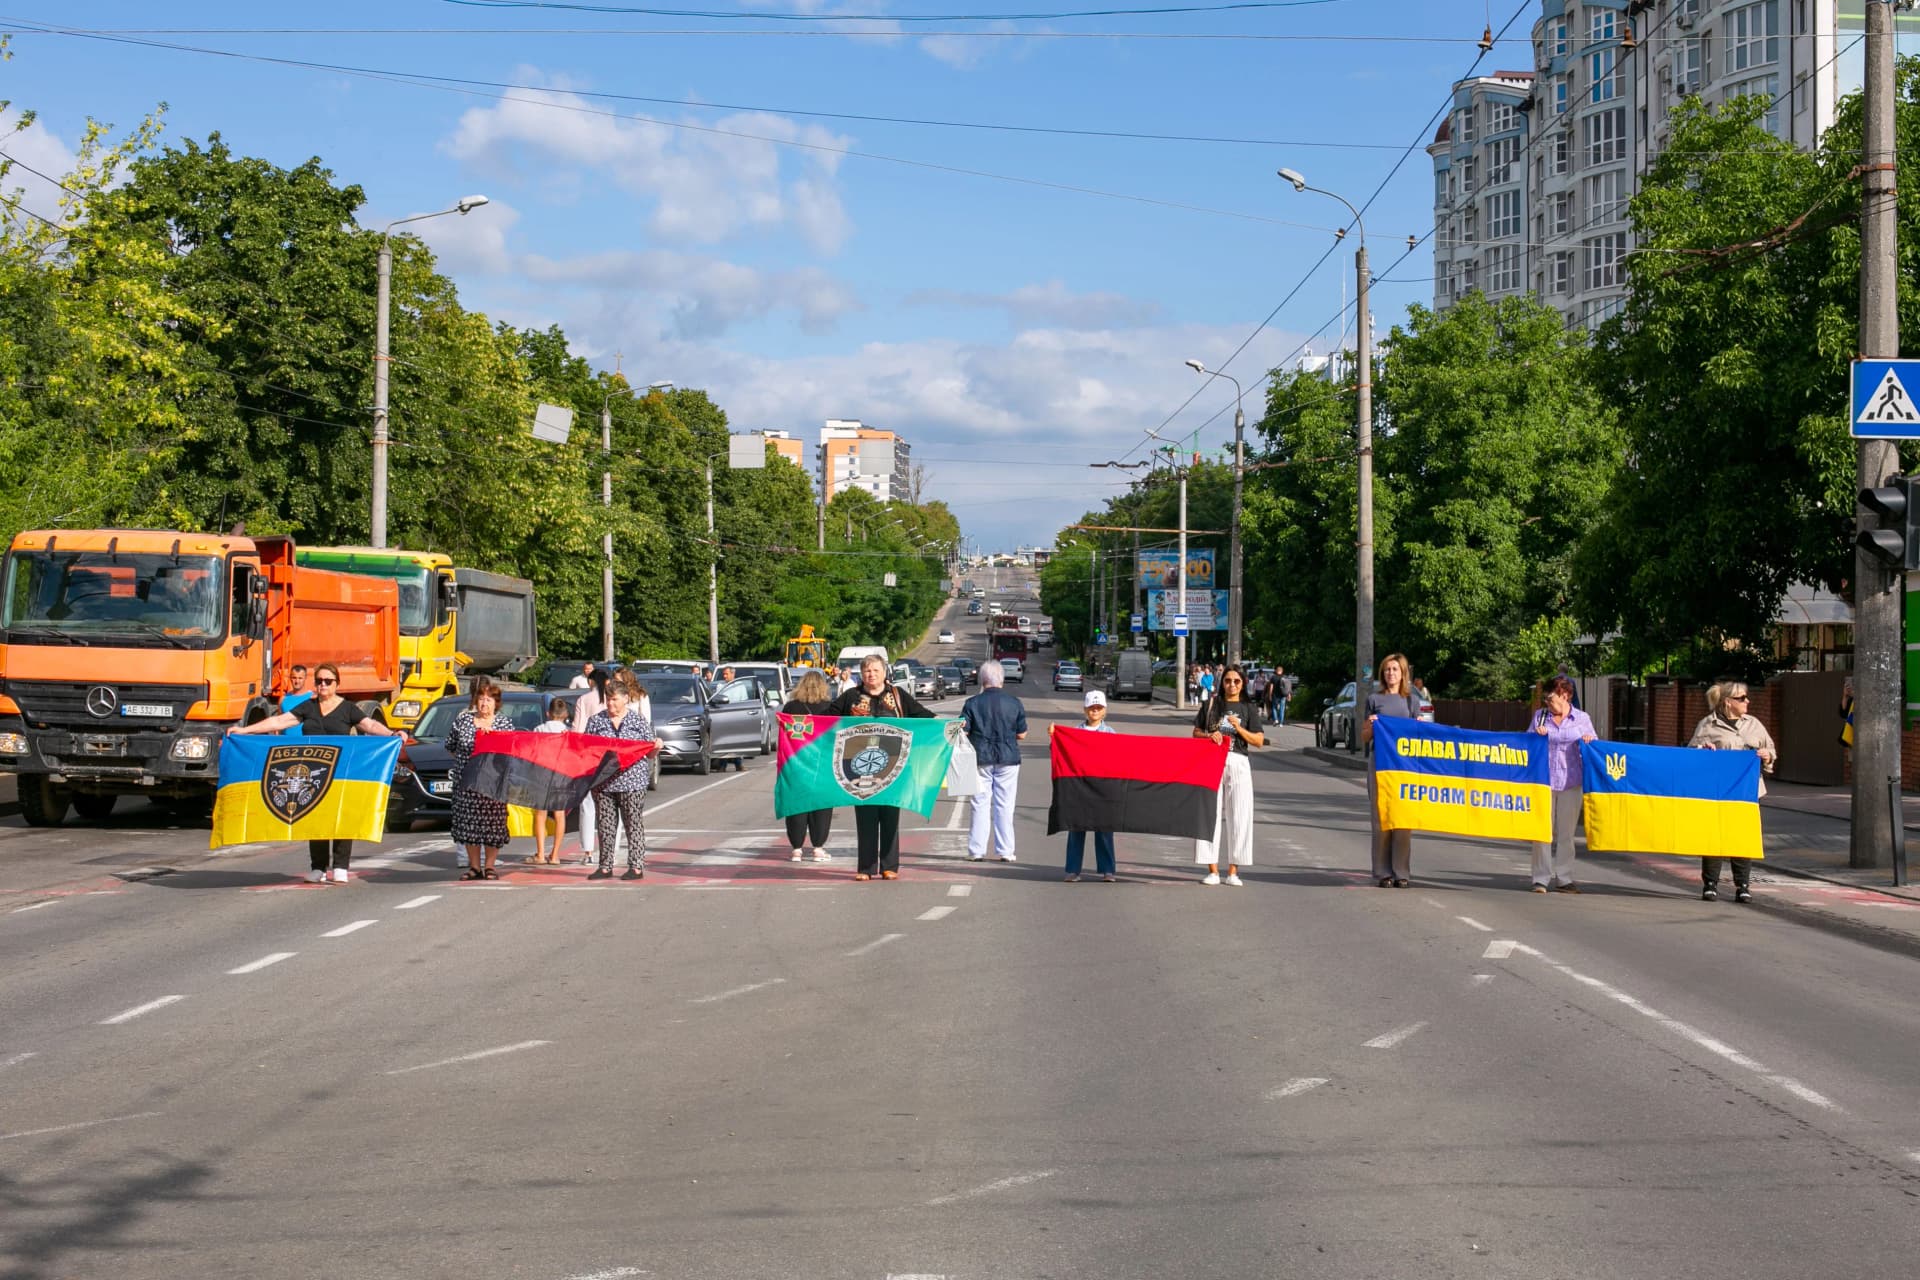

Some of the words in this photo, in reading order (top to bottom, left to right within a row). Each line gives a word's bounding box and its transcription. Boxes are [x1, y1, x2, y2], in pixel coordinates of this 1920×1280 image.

[275, 748, 299, 758] 462
[303, 748, 334, 760] ОПБ
[1397, 737, 1456, 760] СЛАВА
[1400, 783, 1466, 805] ГЕРОЯМ
[1470, 789, 1531, 812] СЛАВА!
